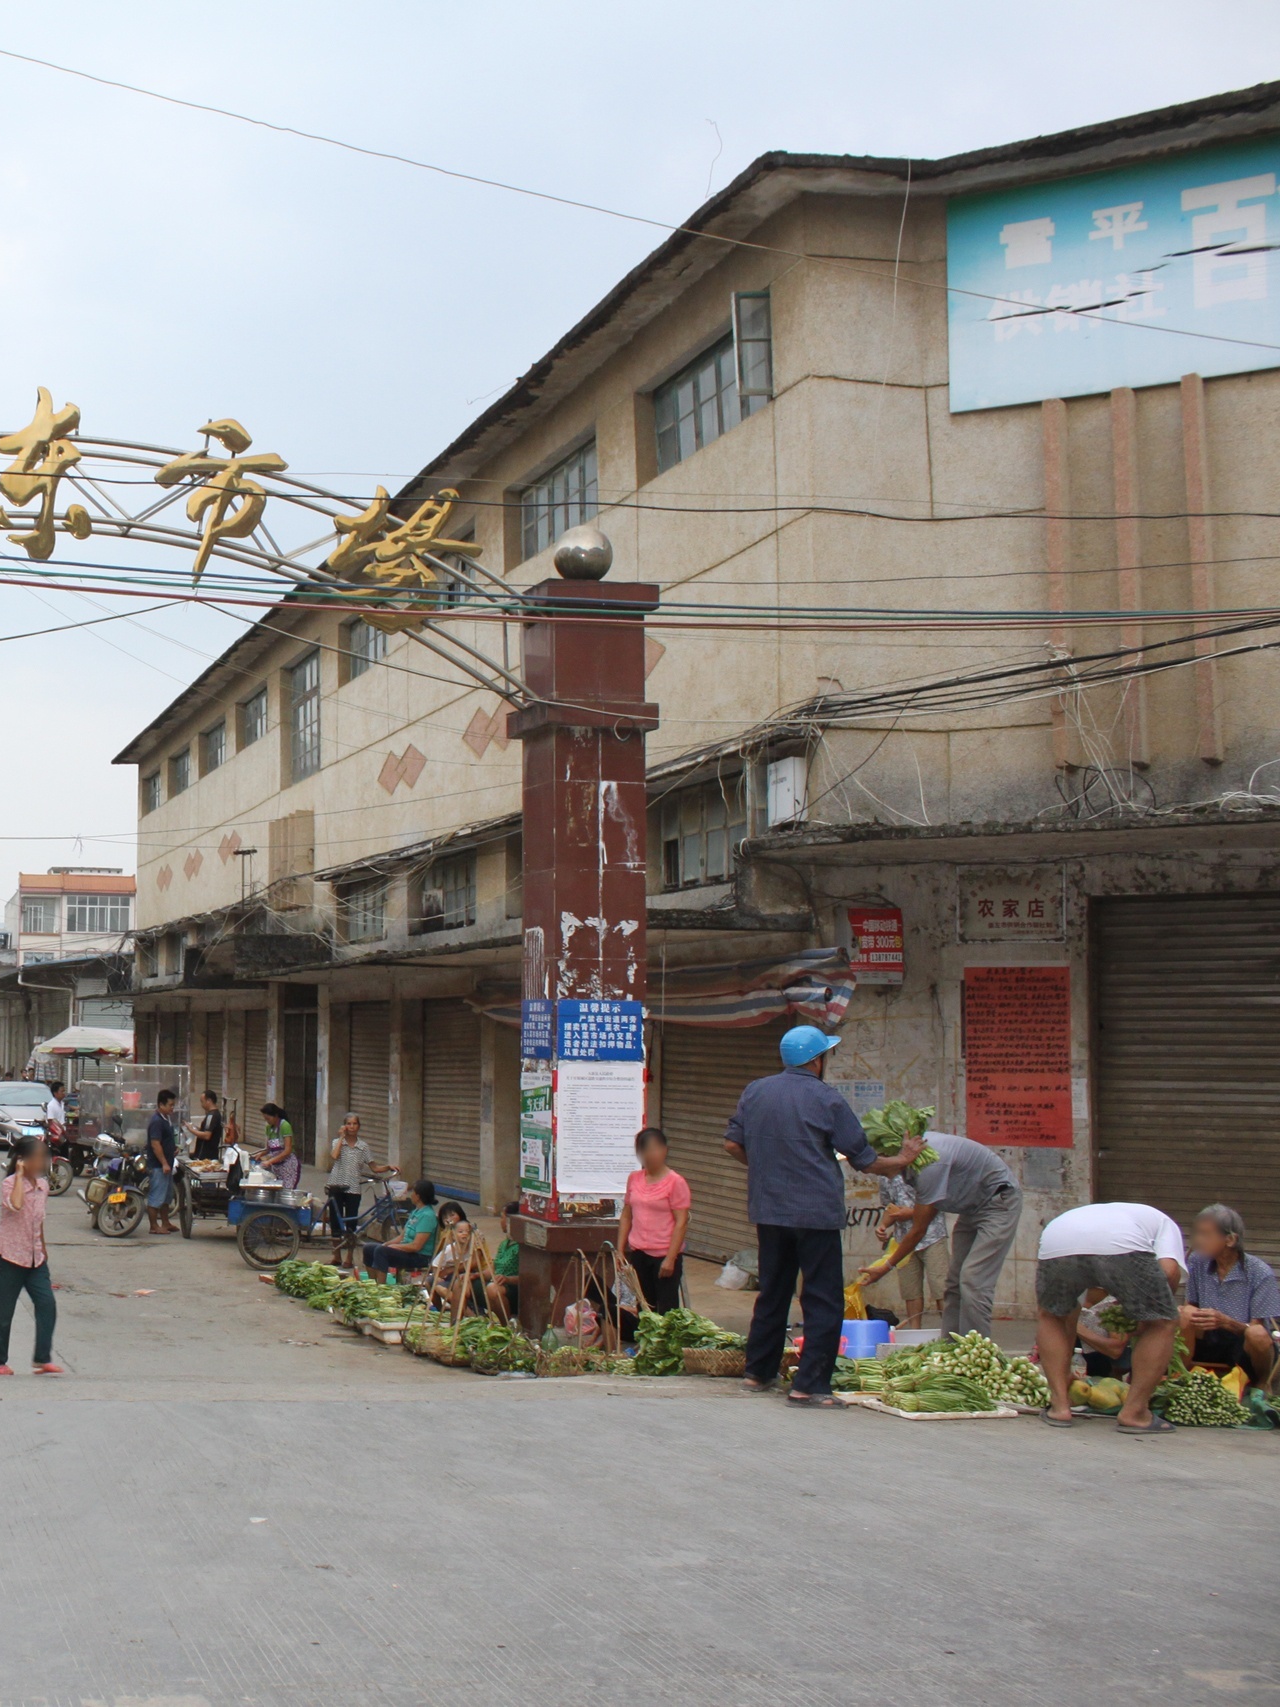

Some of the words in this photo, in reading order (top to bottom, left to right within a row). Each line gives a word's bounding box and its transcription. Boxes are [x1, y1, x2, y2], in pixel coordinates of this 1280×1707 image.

[987, 272, 1168, 343] 供销社
[977, 898, 1045, 918] 农家店
[579, 1002, 621, 1013] 温馨提示
[579, 1015, 637, 1023] 严禁在街道两旁
